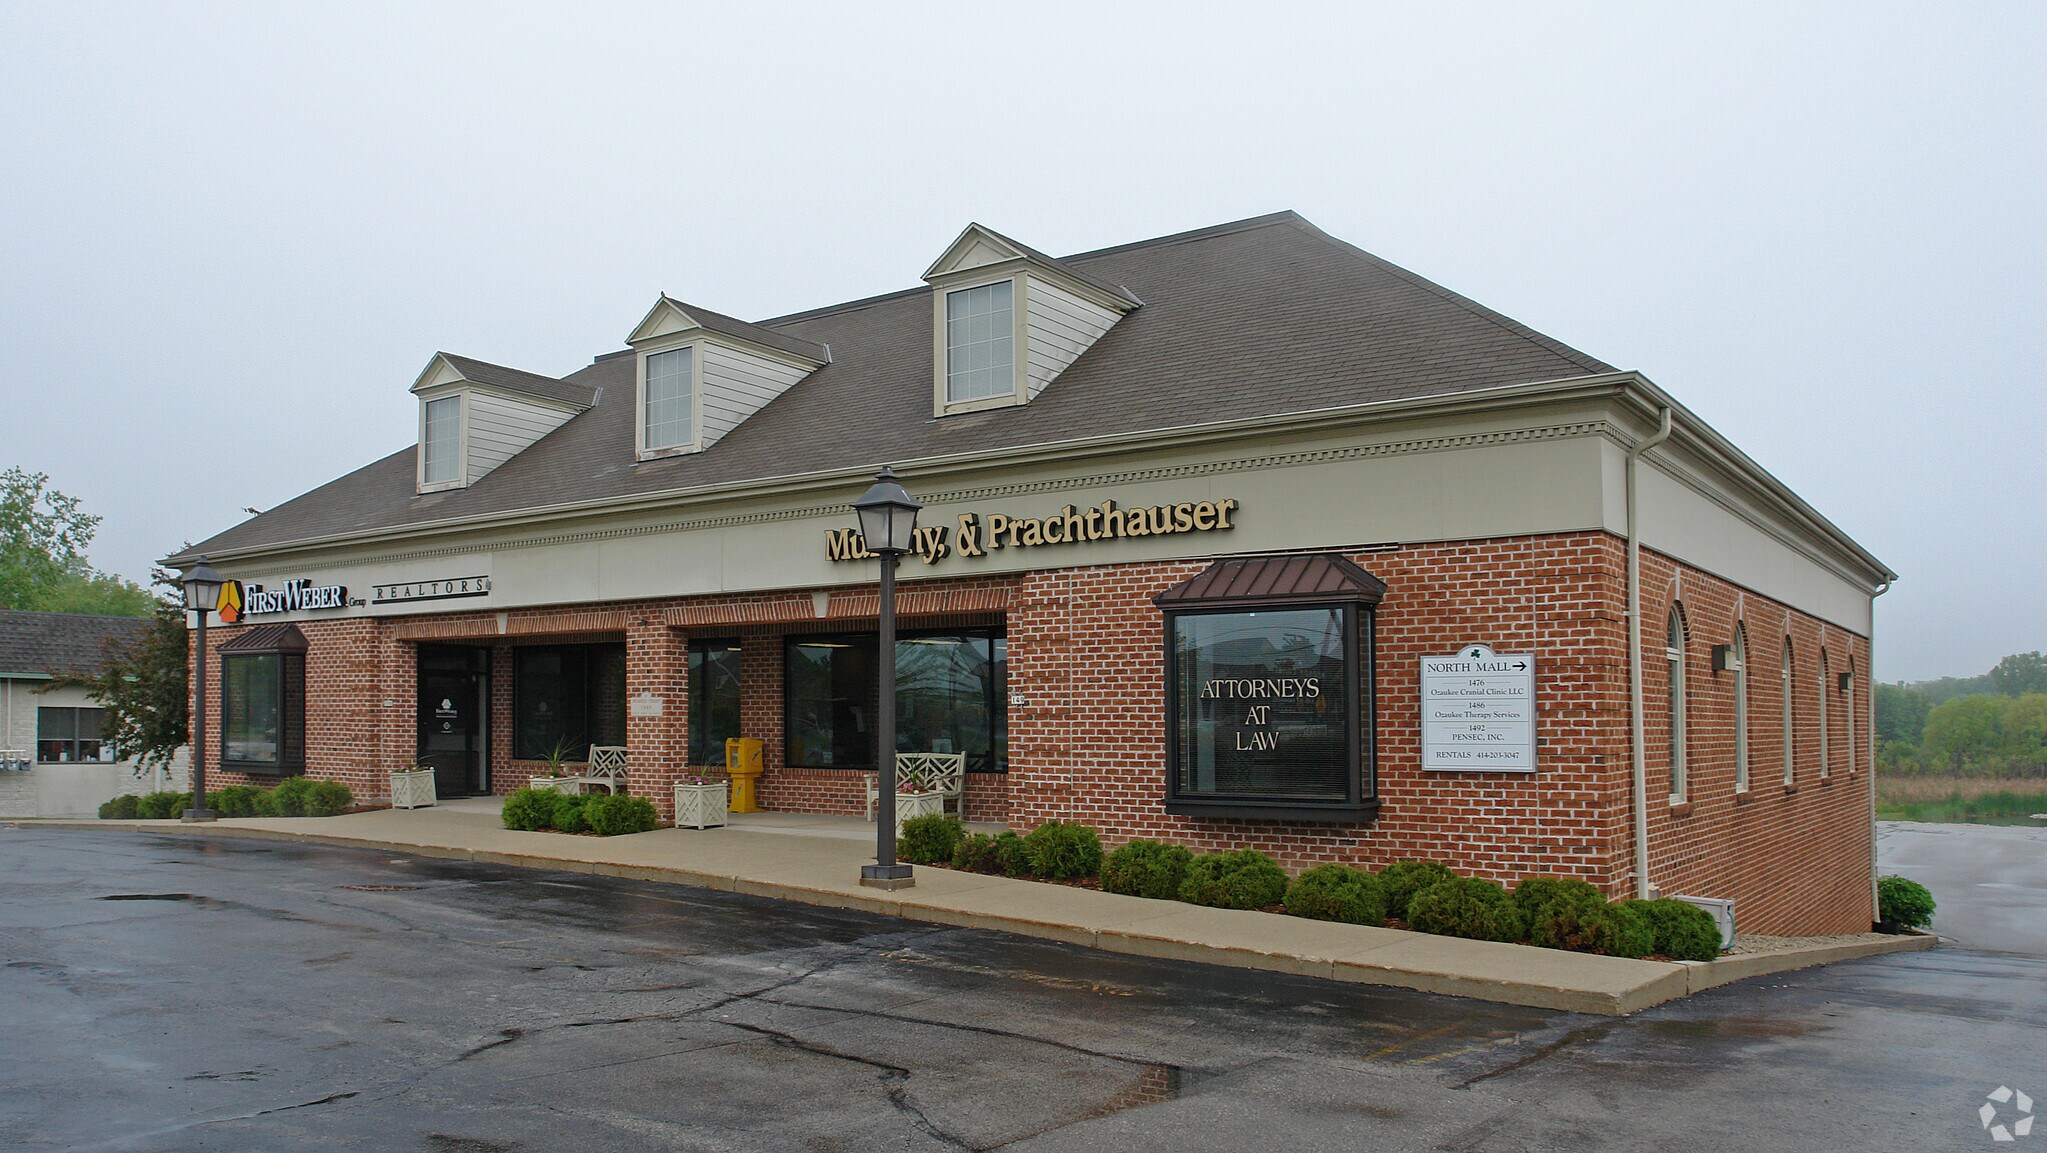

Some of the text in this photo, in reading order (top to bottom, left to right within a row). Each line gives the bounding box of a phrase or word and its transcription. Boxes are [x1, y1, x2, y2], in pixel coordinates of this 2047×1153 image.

[824, 498, 1237, 565] Muy, & Prachthauser
[1427, 662, 1511, 673] NORTH MALL
[1468, 679, 1485, 687] 1476
[1200, 678, 1320, 699] ATTORNEYS
[1430, 688, 1459, 696] Ozaukee
[1460, 688, 1485, 696] Cranial
[1245, 705, 1271, 725] AT
[1434, 710, 1521, 720] Ozaukee Therapy Services
[1469, 724, 1486, 732] 1492
[1235, 731, 1280, 751] LAW
[1452, 733, 1505, 741] PENSEC, INC.
[1436, 751, 1472, 759] RENTALS
